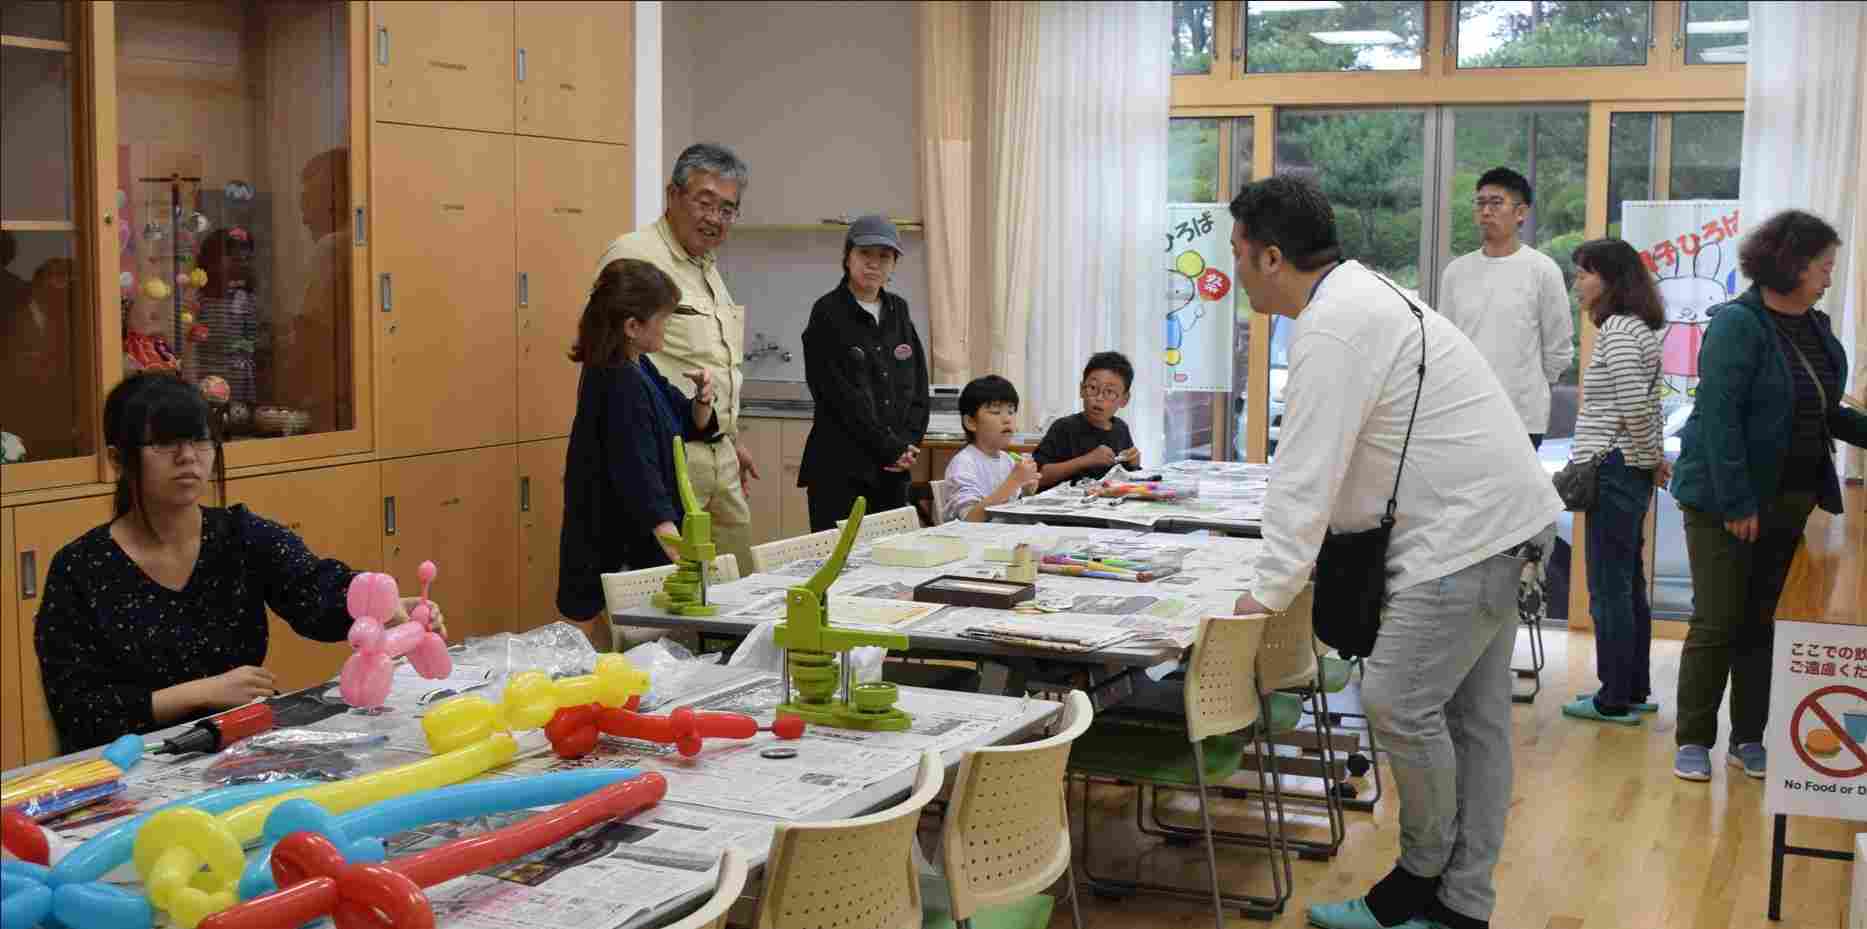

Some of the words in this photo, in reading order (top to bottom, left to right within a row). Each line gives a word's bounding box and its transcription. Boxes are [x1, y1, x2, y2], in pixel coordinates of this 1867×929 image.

[1784, 779, 1802, 790] No
[1805, 781, 1837, 793] Food
[1840, 786, 1854, 795] or
